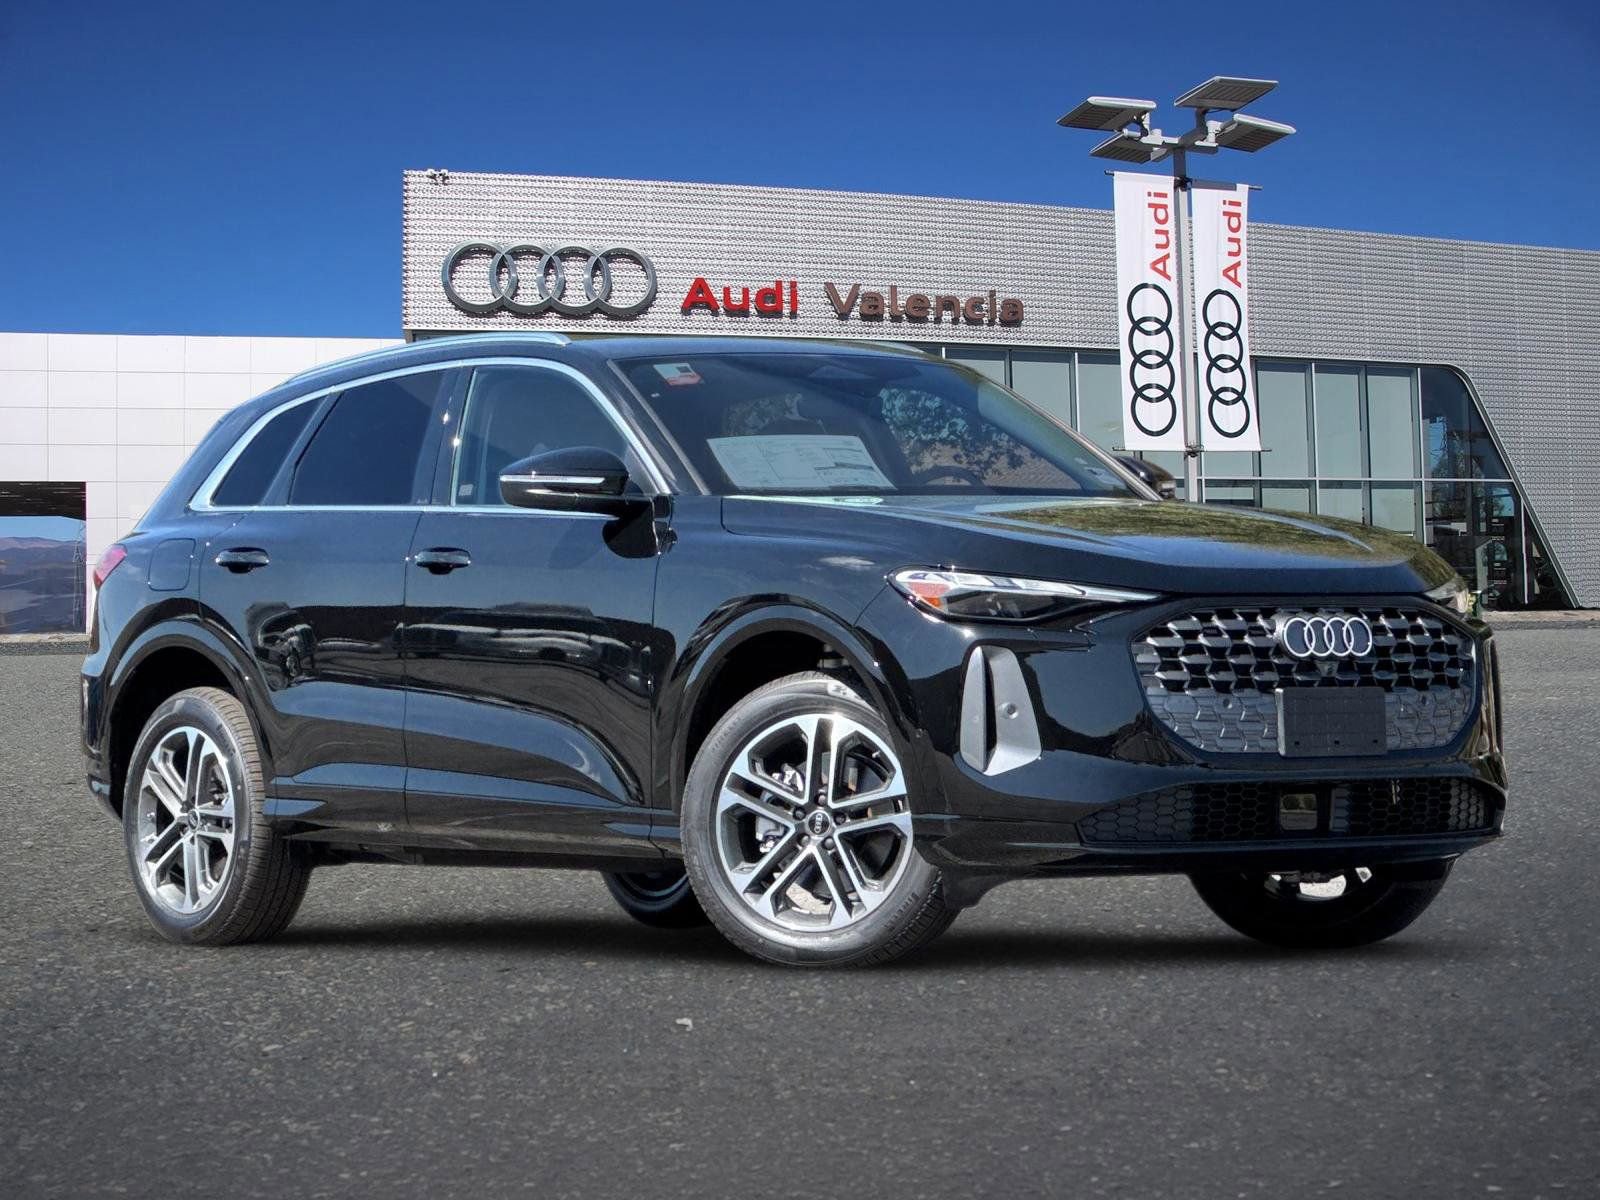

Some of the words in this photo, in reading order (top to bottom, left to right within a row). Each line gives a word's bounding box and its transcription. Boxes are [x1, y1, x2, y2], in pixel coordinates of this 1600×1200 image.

[1147, 191, 1172, 282] Audi
[1222, 199, 1242, 289] Audi
[680, 277, 799, 317] Audi
[824, 281, 1024, 326] Valencia
